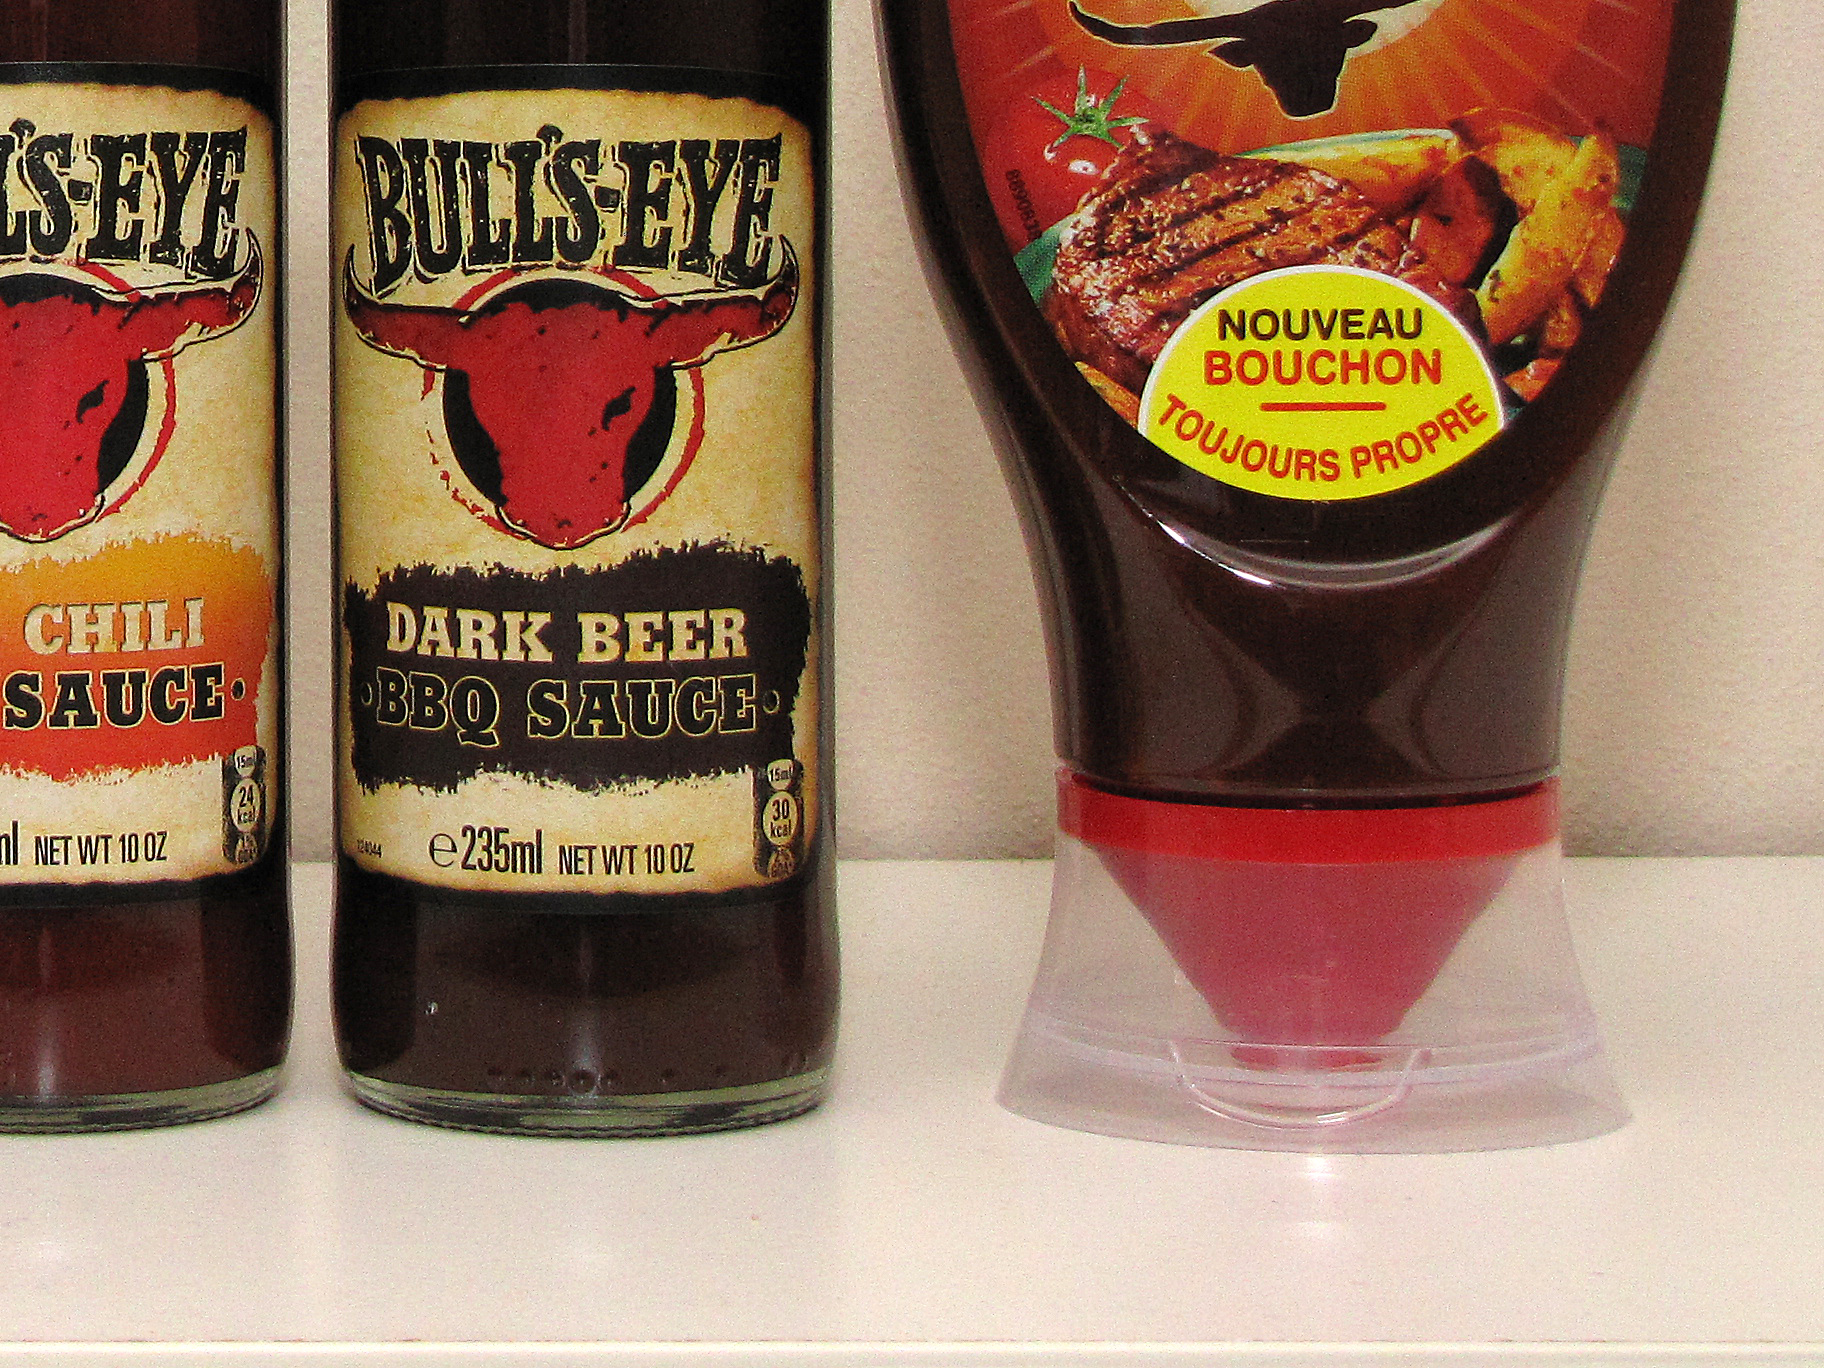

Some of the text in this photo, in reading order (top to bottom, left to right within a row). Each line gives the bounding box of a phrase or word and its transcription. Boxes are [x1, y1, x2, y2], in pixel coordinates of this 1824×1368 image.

[1217, 308, 1422, 341] NOUVEAU
[1204, 349, 1443, 385] BOUCHON
[1158, 393, 1488, 482] TOUJOURS PROPRE
[24, 598, 205, 654] CHILI
[386, 601, 747, 663] DARK BEER
[3, 663, 225, 731] SAUCE
[376, 667, 757, 748] BBQ SAUCE
[239, 785, 254, 807] 24
[772, 798, 790, 821] 30
[770, 819, 791, 837] kcal
[35, 835, 73, 866] NET
[77, 834, 113, 865] WT
[119, 833, 139, 864] 10
[144, 831, 169, 862] OZ
[559, 844, 597, 875] NET
[602, 845, 638, 875] WT
[644, 843, 666, 874] 10
[671, 842, 696, 873] OZ
